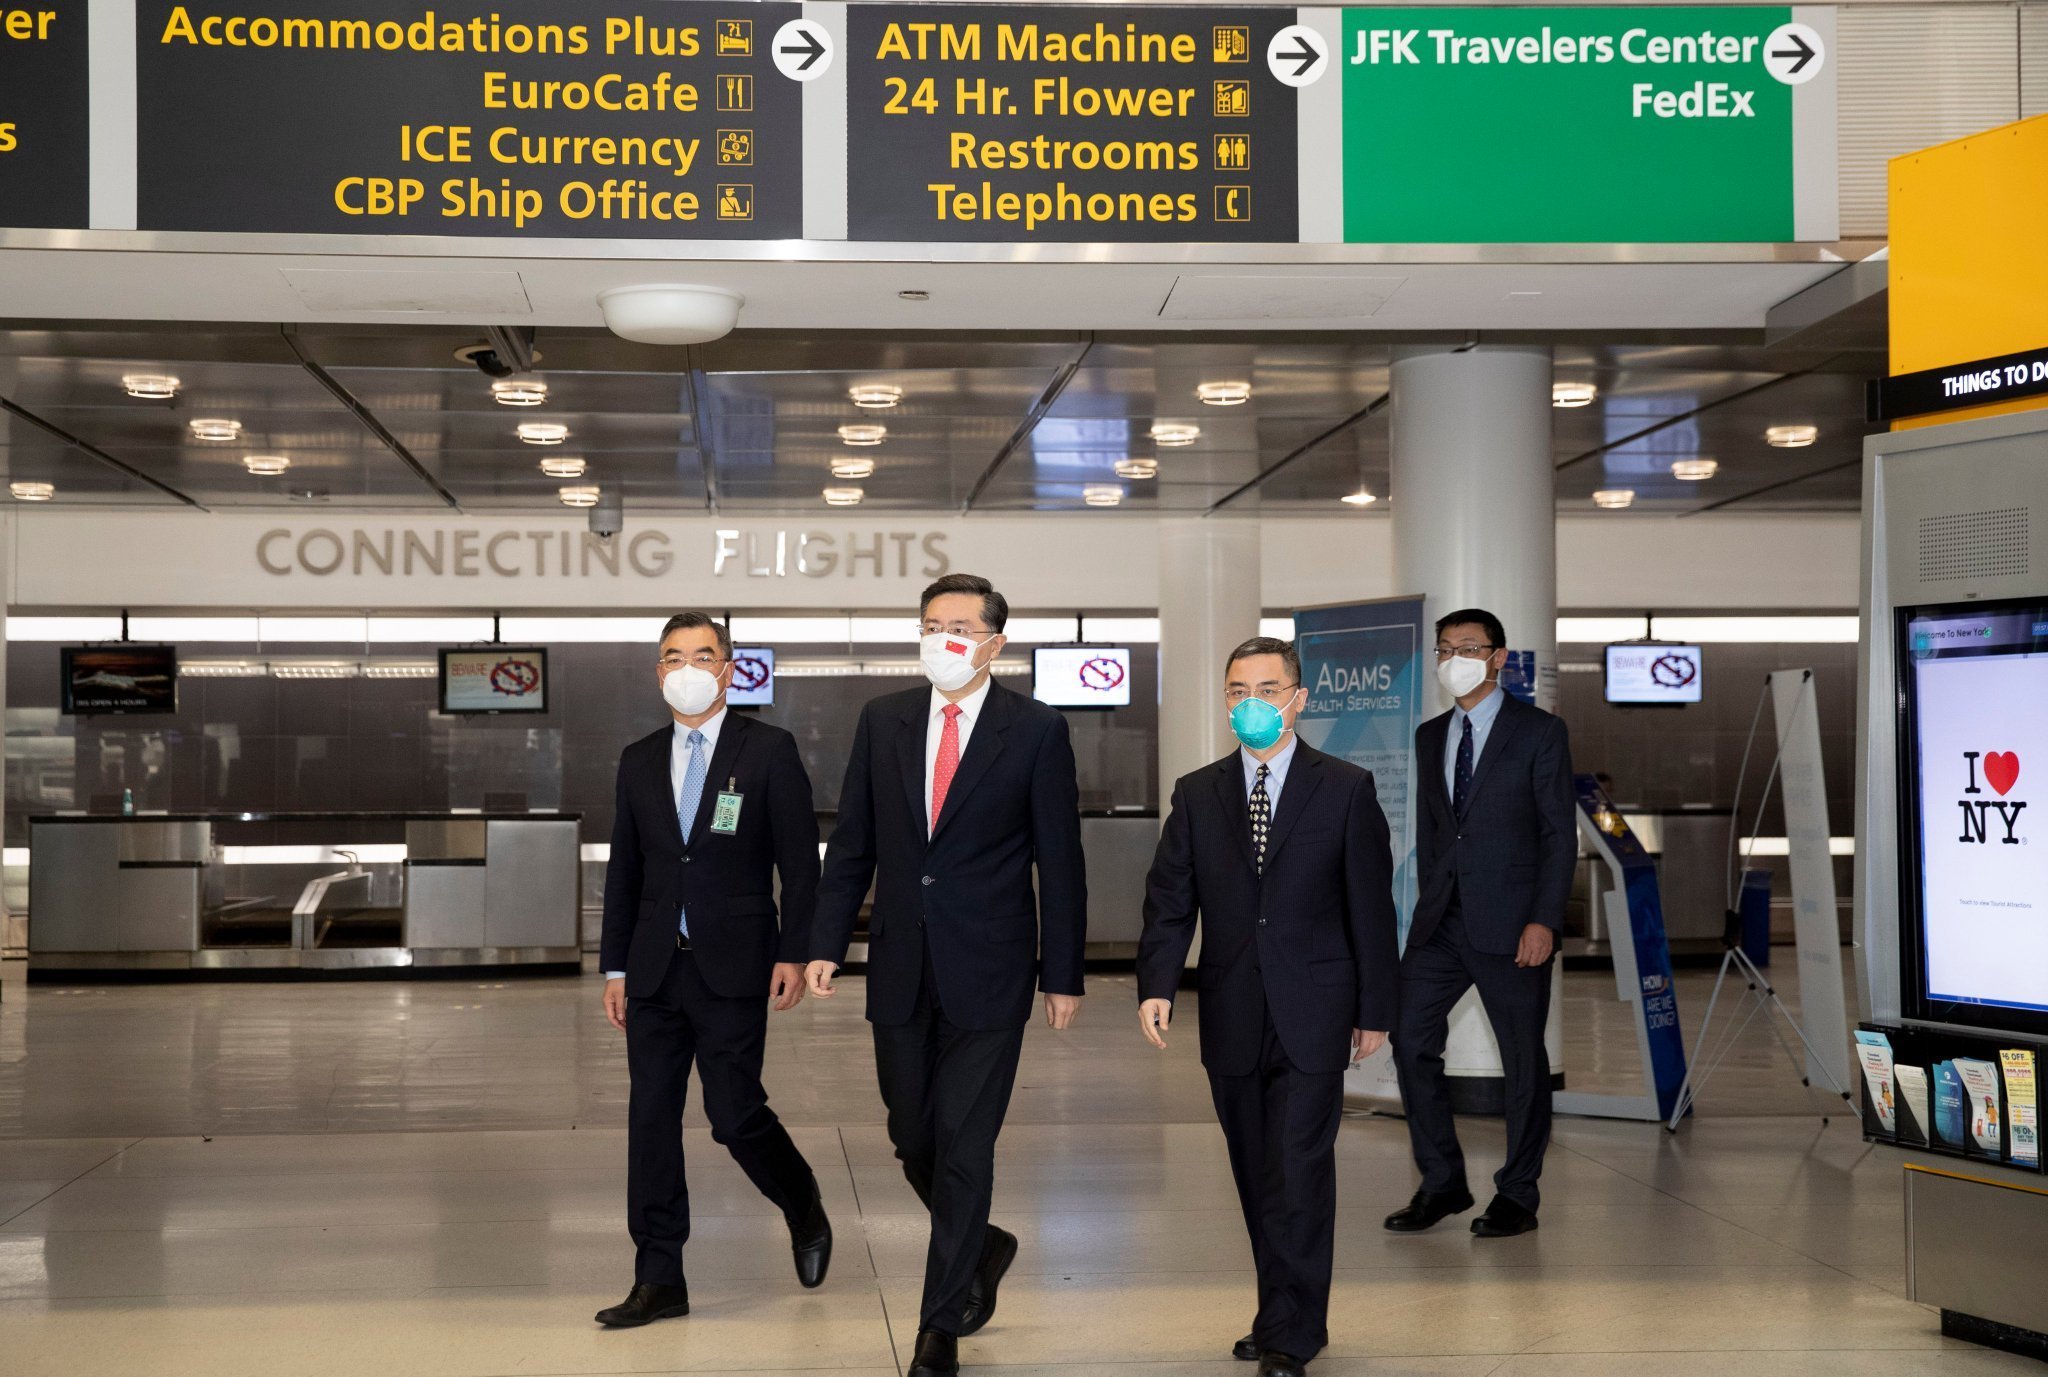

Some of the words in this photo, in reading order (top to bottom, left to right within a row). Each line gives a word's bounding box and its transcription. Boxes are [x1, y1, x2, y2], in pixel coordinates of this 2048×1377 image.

[0, 10, 56, 40] er
[160, 7, 590, 55] Accommodations
[605, 16, 701, 57] Plus
[876, 23, 981, 61] ATM
[997, 23, 1196, 64] Machine
[1350, 29, 1420, 65] JFK
[1427, 26, 1614, 65] Travelers
[1619, 27, 1759, 64] Center
[484, 71, 699, 112] EuroCafe
[883, 76, 939, 115] 24
[957, 77, 1017, 116] Hr.
[1034, 77, 1196, 117] Flower
[1632, 81, 1756, 118] FedEx
[399, 125, 473, 165] ICE
[489, 127, 701, 176] Currency
[950, 131, 1199, 171] Restrooms
[334, 176, 424, 217] CBP
[441, 177, 544, 229] Ship
[559, 181, 700, 221] Office
[928, 181, 1198, 231] Telephones
[1942, 368, 2001, 397] THINGS
[2004, 364, 2028, 387] TO
[256, 528, 674, 577] CONNECTING
[713, 528, 950, 578] FLIGHTS
[1947, 630, 1955, 638] To
[1956, 629, 1972, 637] New
[1314, 661, 1392, 695] ADAMS
[1347, 694, 1401, 712] SERVICES
[1963, 751, 1981, 794] I
[1958, 800, 2027, 845] NY
[1642, 975, 1663, 990] HOW
